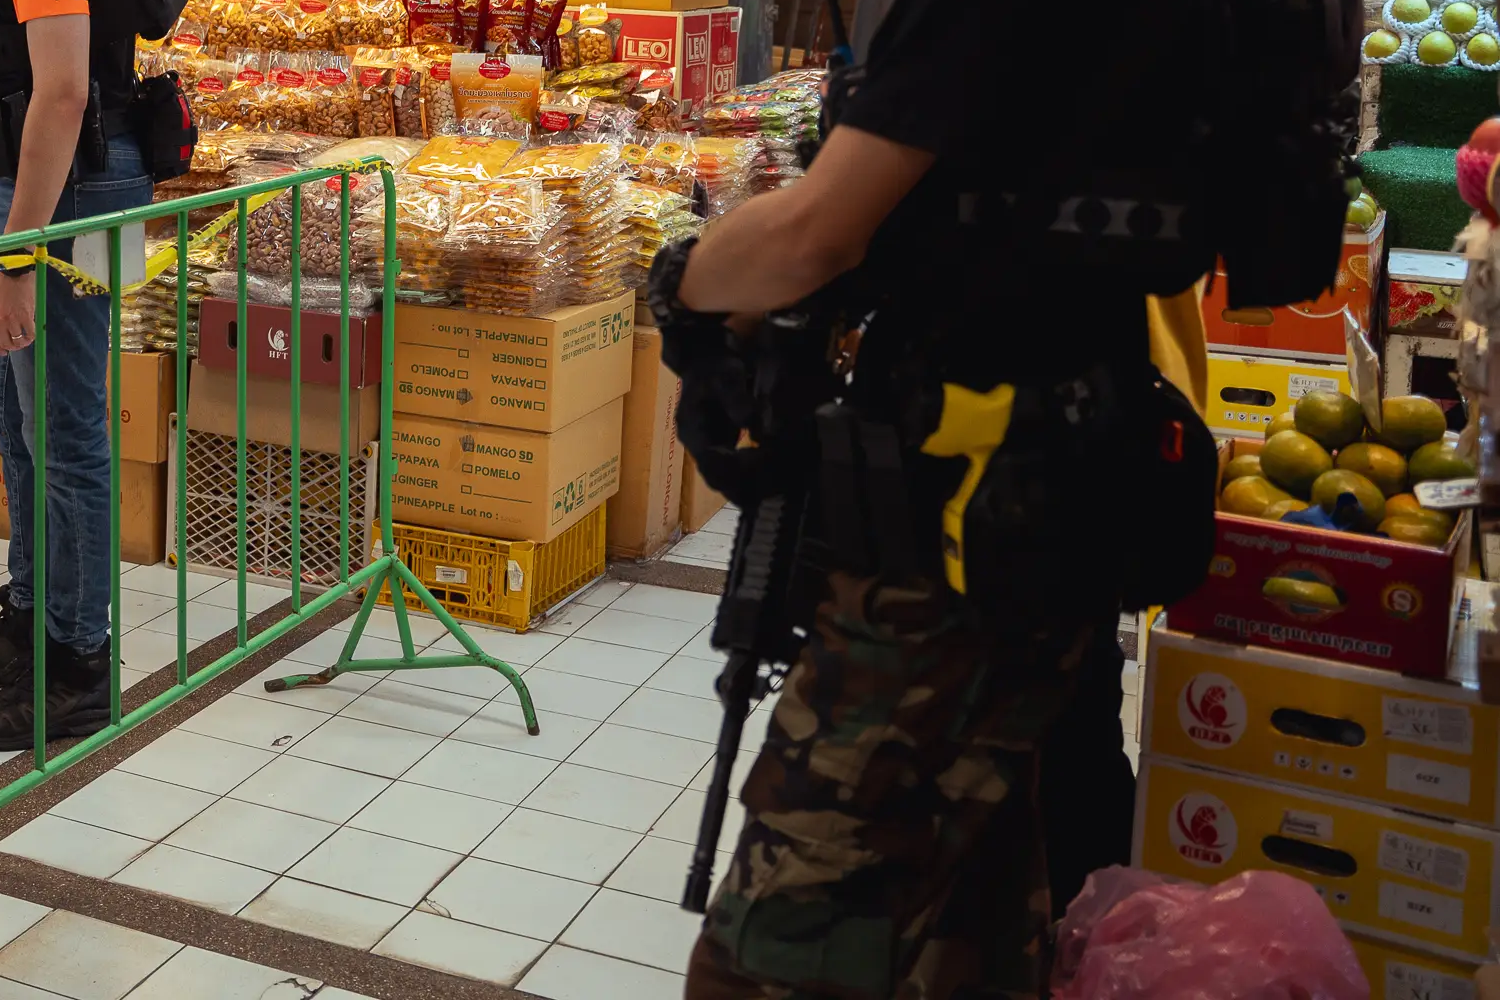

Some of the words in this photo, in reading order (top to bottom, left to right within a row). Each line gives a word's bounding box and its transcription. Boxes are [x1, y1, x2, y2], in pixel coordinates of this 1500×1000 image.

[627, 39, 667, 59] LEO
[688, 36, 706, 61] LEO
[715, 68, 734, 93] LEO
[438, 325, 451, 333] no
[453, 327, 470, 338] Lot
[475, 328, 535, 346] PINEAPPLE
[269, 350, 289, 360] HFT
[492, 352, 534, 367] GINGER
[411, 364, 456, 378] POMELO
[398, 382, 413, 394] SD
[491, 373, 533, 388] PAPAYA
[415, 385, 455, 400] MANGO
[490, 395, 533, 410] MANGO
[400, 433, 441, 447] MANGO
[476, 444, 517, 459] MANGO
[519, 450, 533, 461] SD
[399, 454, 440, 468] PAPAYA
[475, 466, 521, 481] POMELO
[398, 475, 439, 489] GINGER
[397, 495, 455, 513] PINEAPPLE
[460, 505, 476, 517] Lot
[479, 511, 493, 519] no
